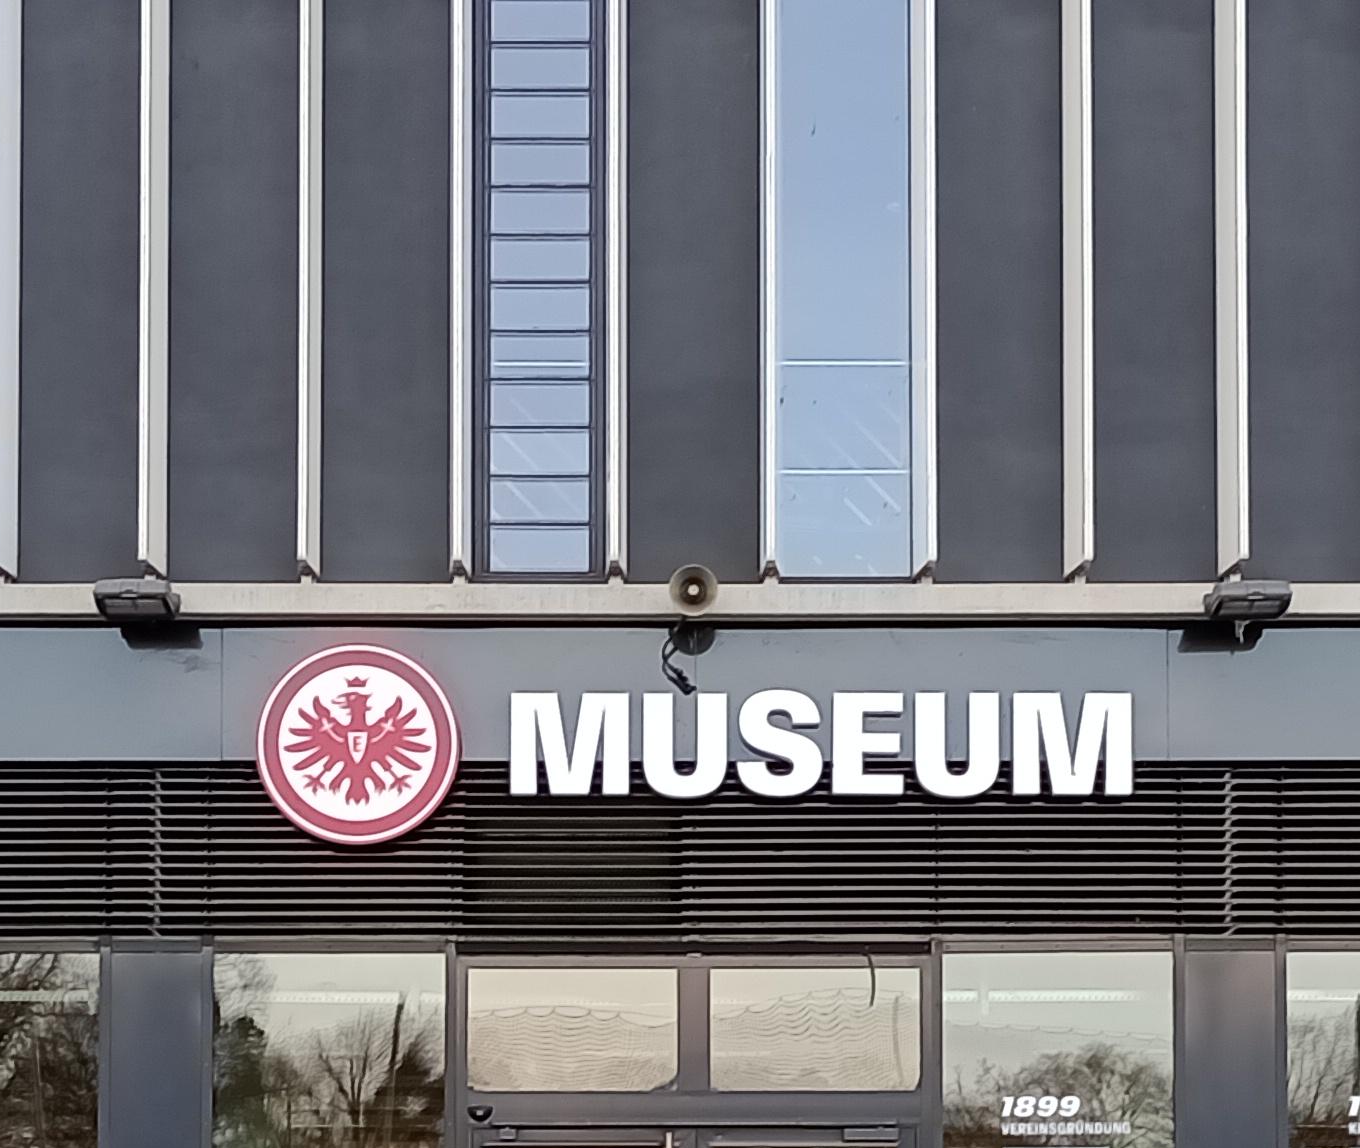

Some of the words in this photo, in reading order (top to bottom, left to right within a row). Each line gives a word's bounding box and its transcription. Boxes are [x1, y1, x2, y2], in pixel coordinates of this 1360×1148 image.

[352, 735, 362, 752] E
[508, 690, 1135, 799] MUSEUM
[1001, 1095, 1081, 1118] 1899
[1001, 1121, 1131, 1136] VEREINSGRÜNDUNG
